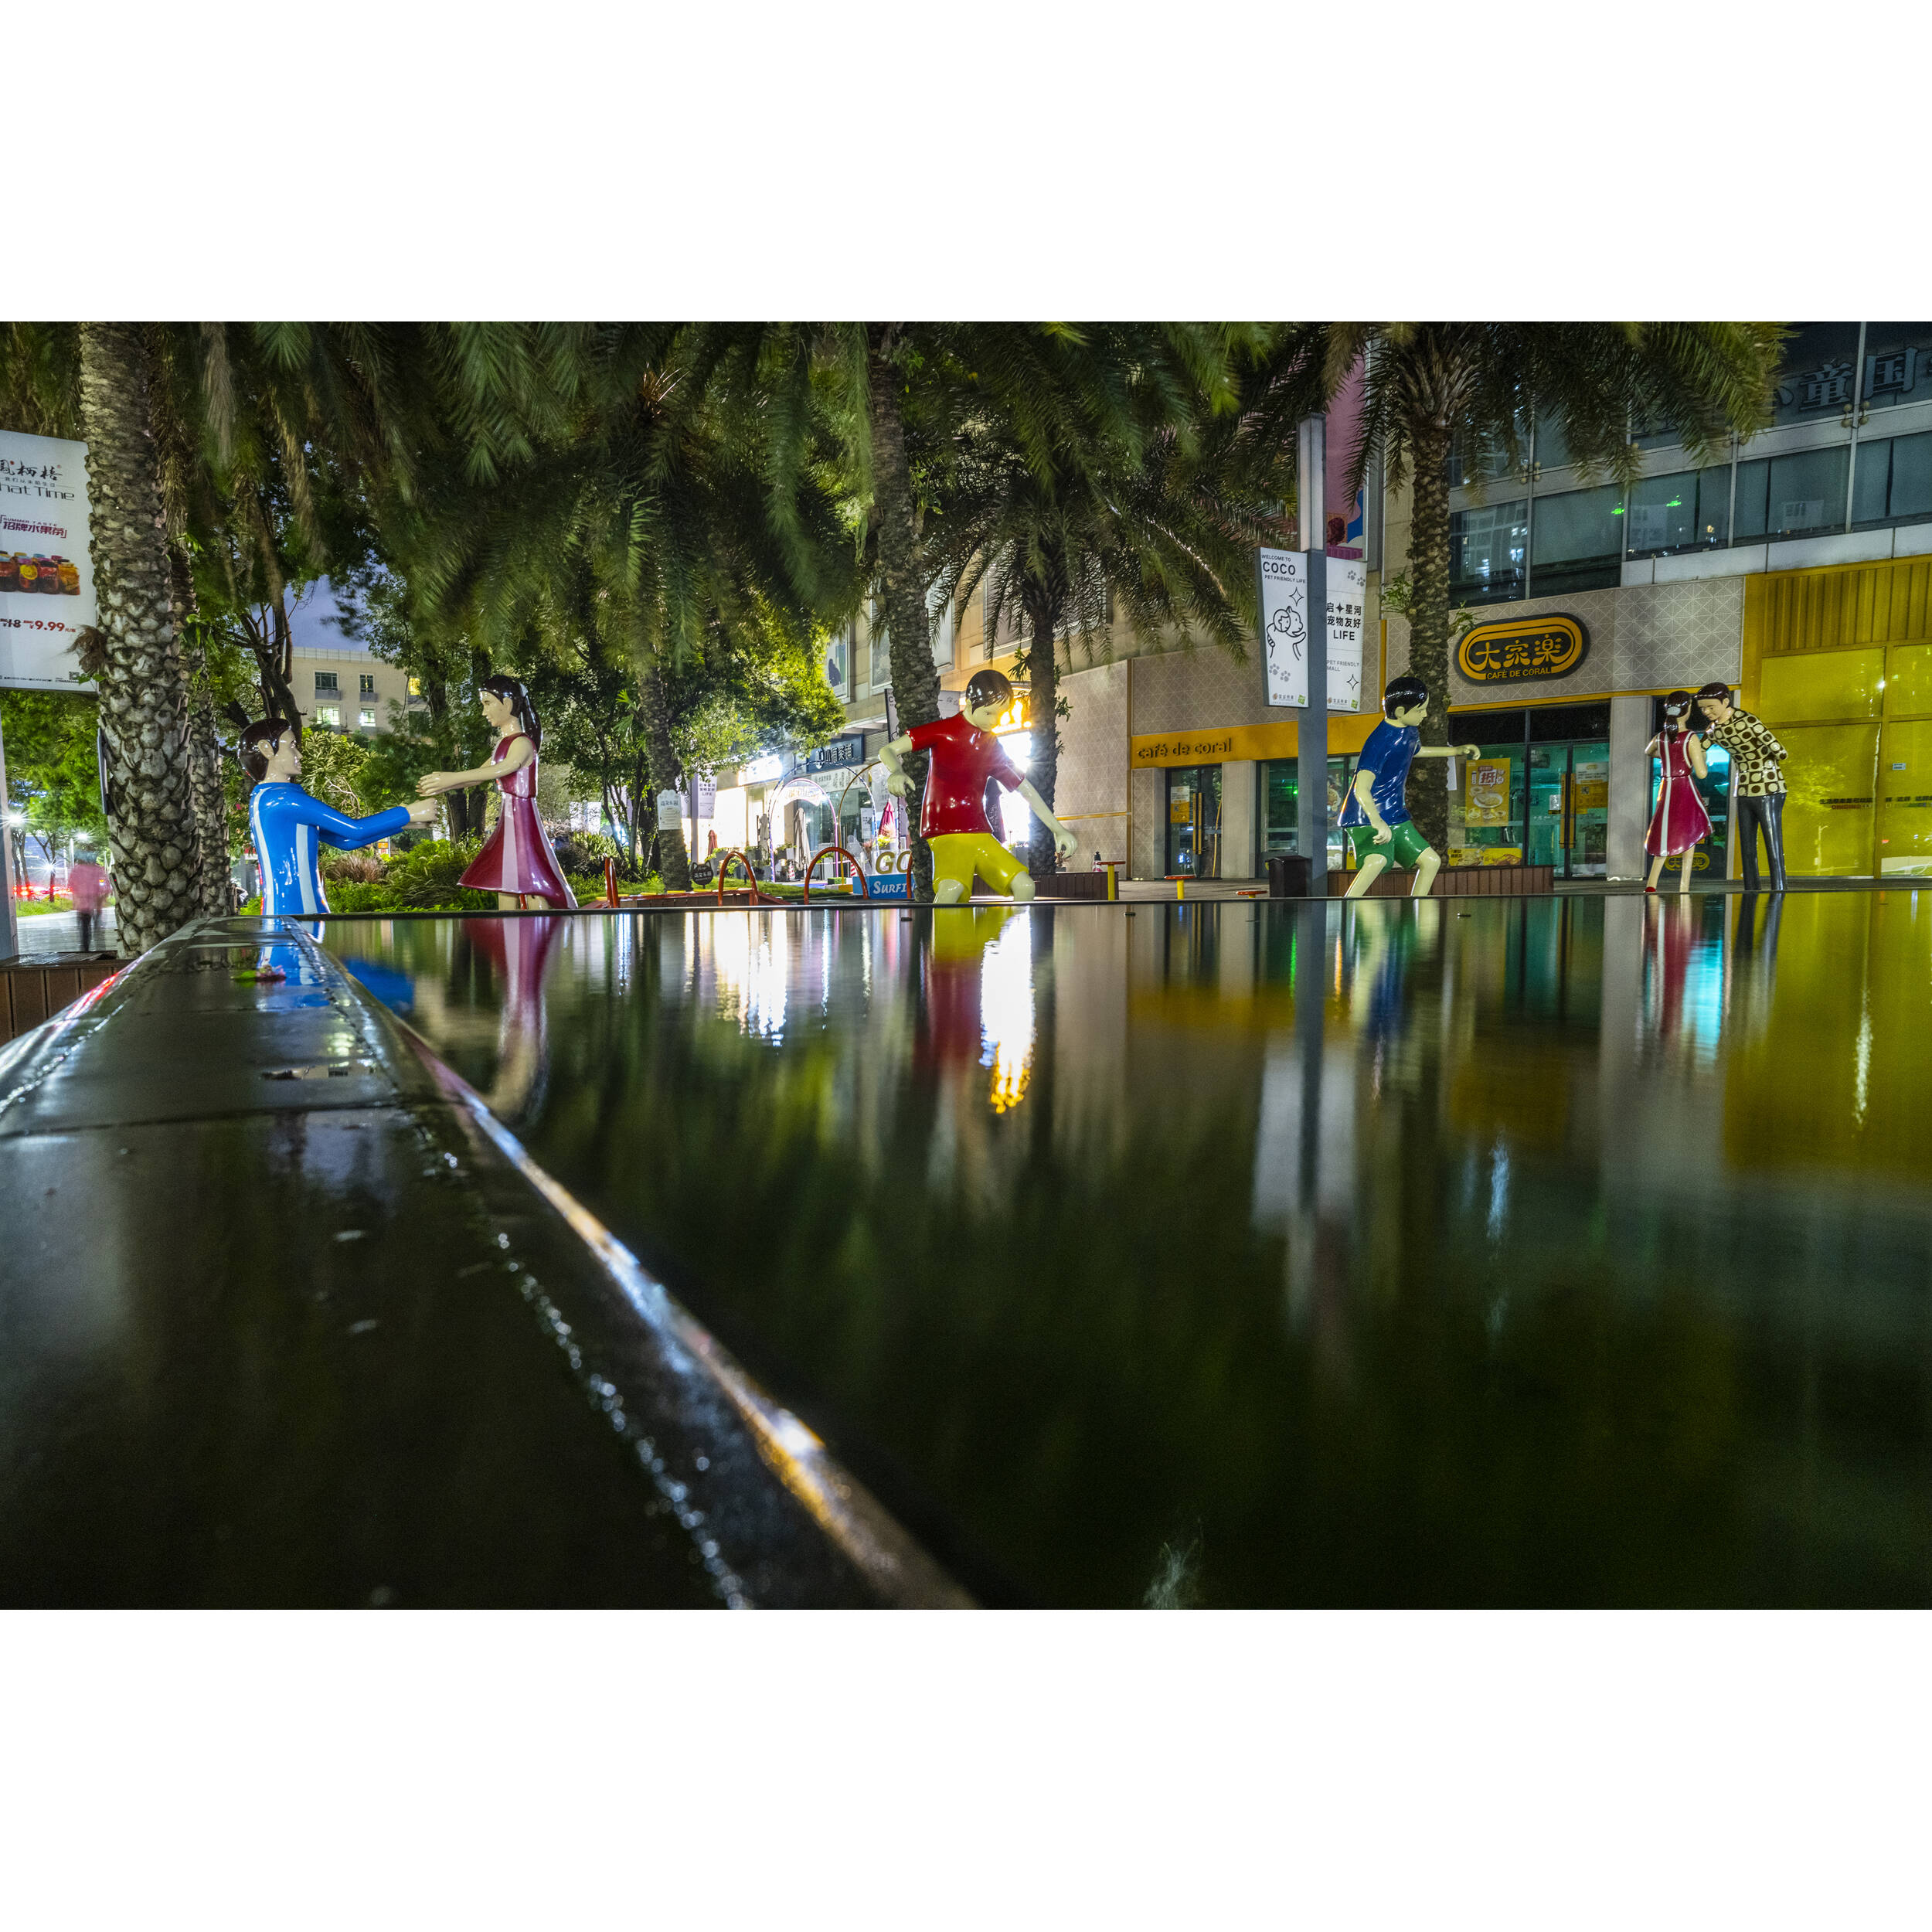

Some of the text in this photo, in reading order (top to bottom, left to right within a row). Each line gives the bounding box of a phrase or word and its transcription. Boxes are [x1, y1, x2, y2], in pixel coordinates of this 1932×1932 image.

[33, 485, 75, 501] Time
[1263, 562, 1296, 575] COCO
[1345, 604, 1362, 616] 星河
[1327, 616, 1361, 628] 宠物友好
[1333, 630, 1355, 641] LIFE
[1522, 667, 1551, 676] CORAL
[1138, 737, 1232, 759] café de coral
